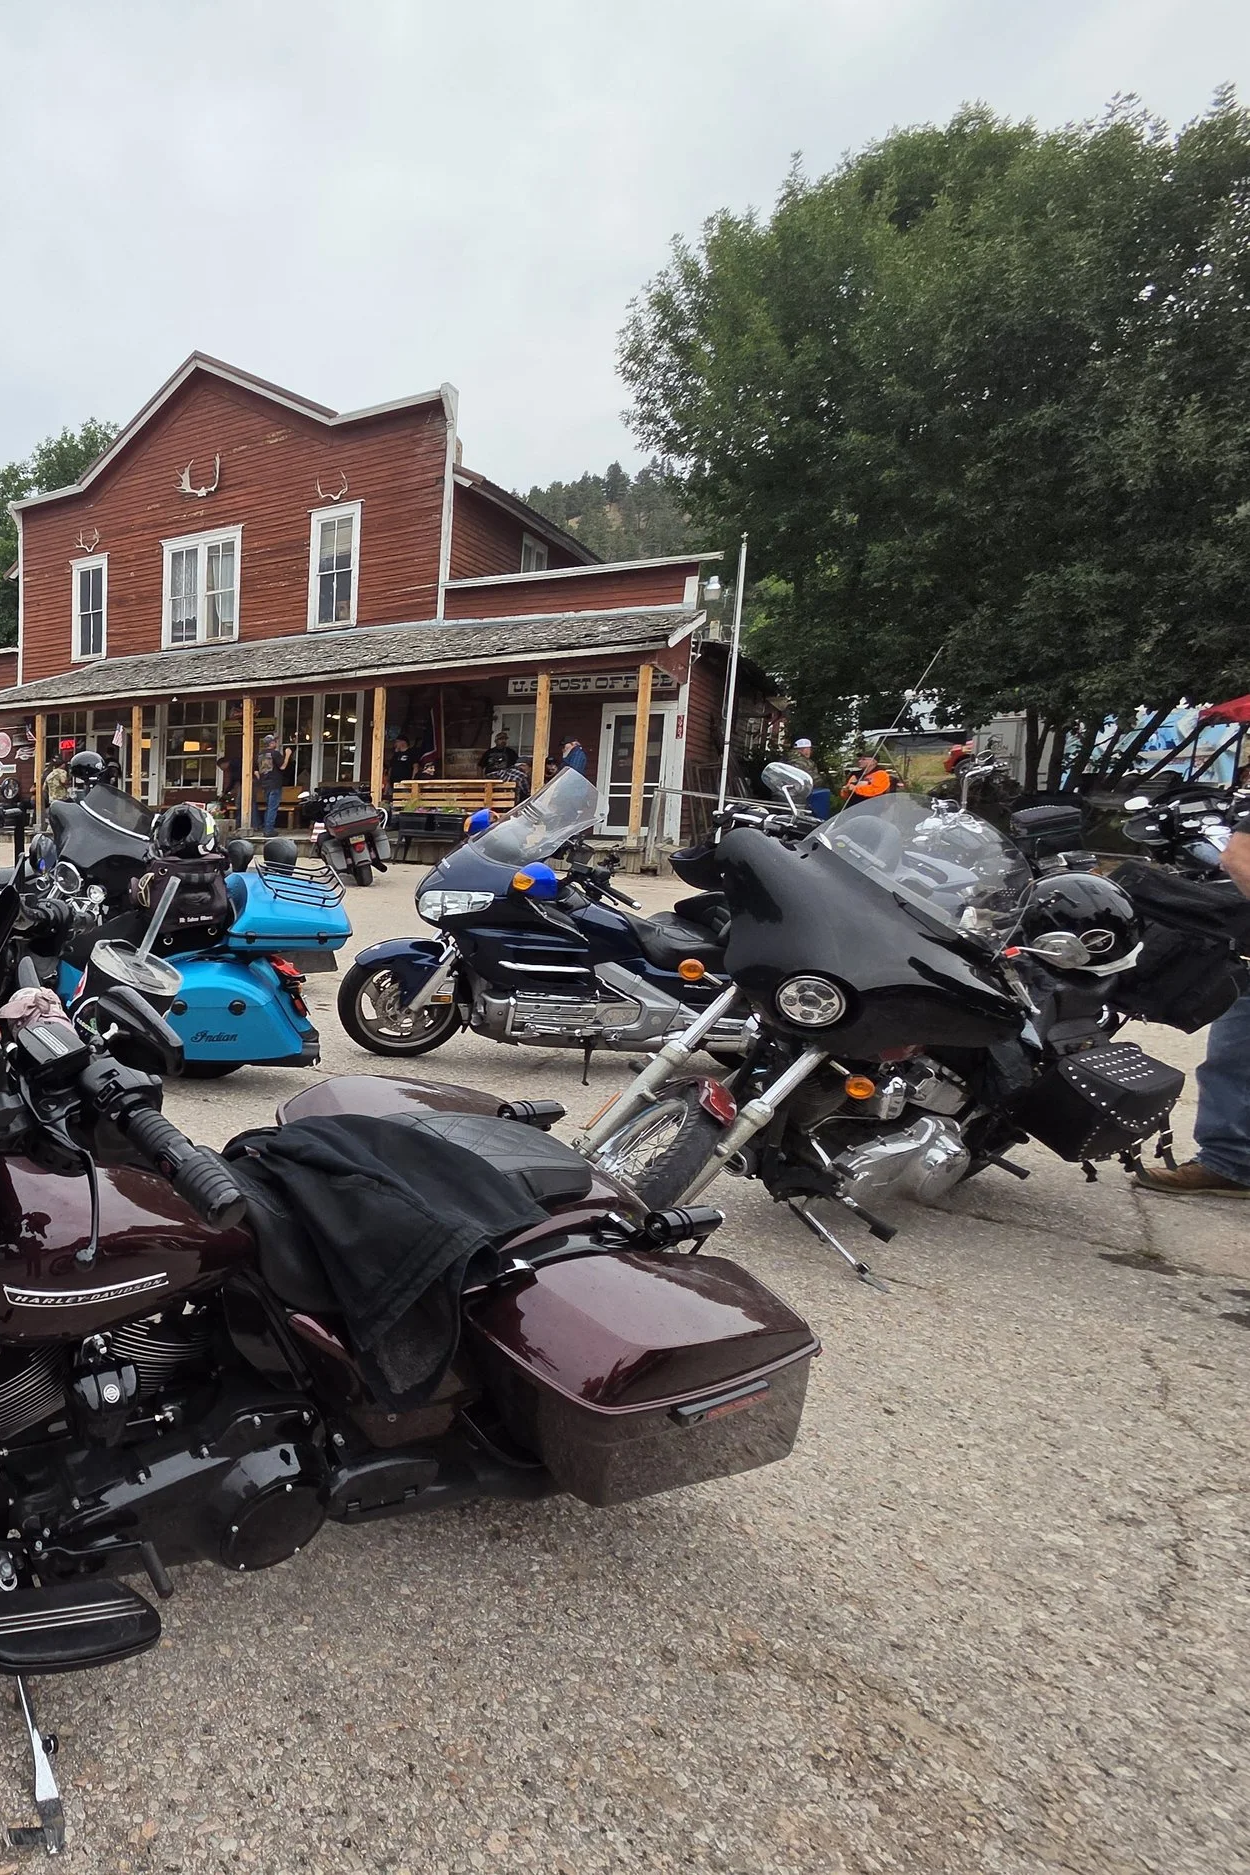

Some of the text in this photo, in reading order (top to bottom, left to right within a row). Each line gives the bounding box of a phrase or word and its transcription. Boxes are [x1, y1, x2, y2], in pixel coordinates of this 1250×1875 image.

[549, 677, 592, 691] POST
[595, 674, 673, 689] OFFCE
[190, 1029, 238, 1042] Indian
[13, 1278, 163, 1304] HARLEY-DAVIDSON
